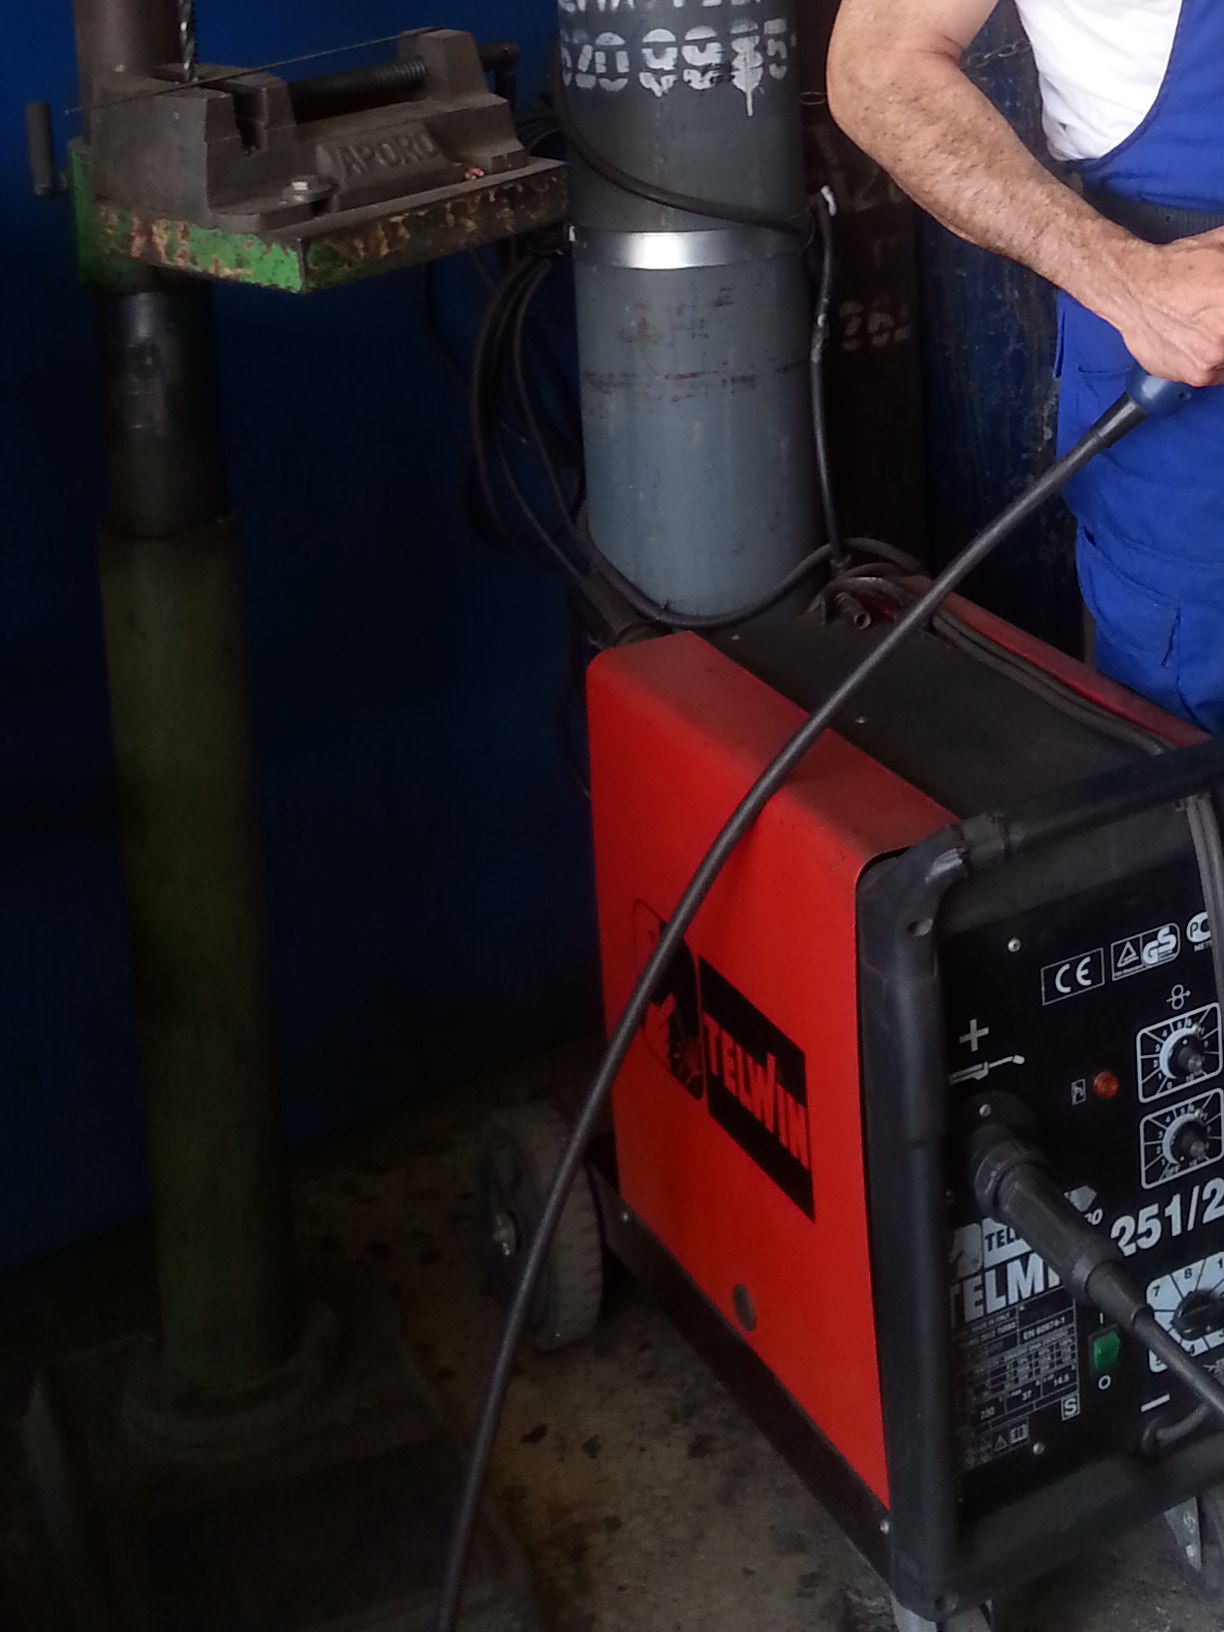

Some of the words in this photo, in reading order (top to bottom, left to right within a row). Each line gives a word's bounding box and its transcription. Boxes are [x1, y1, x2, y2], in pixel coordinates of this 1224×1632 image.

[1055, 956, 1092, 993] CE
[701, 1012, 809, 1172] TELWIN
[984, 1227, 1019, 1252] TEL
[1152, 1285, 1160, 1298] 7
